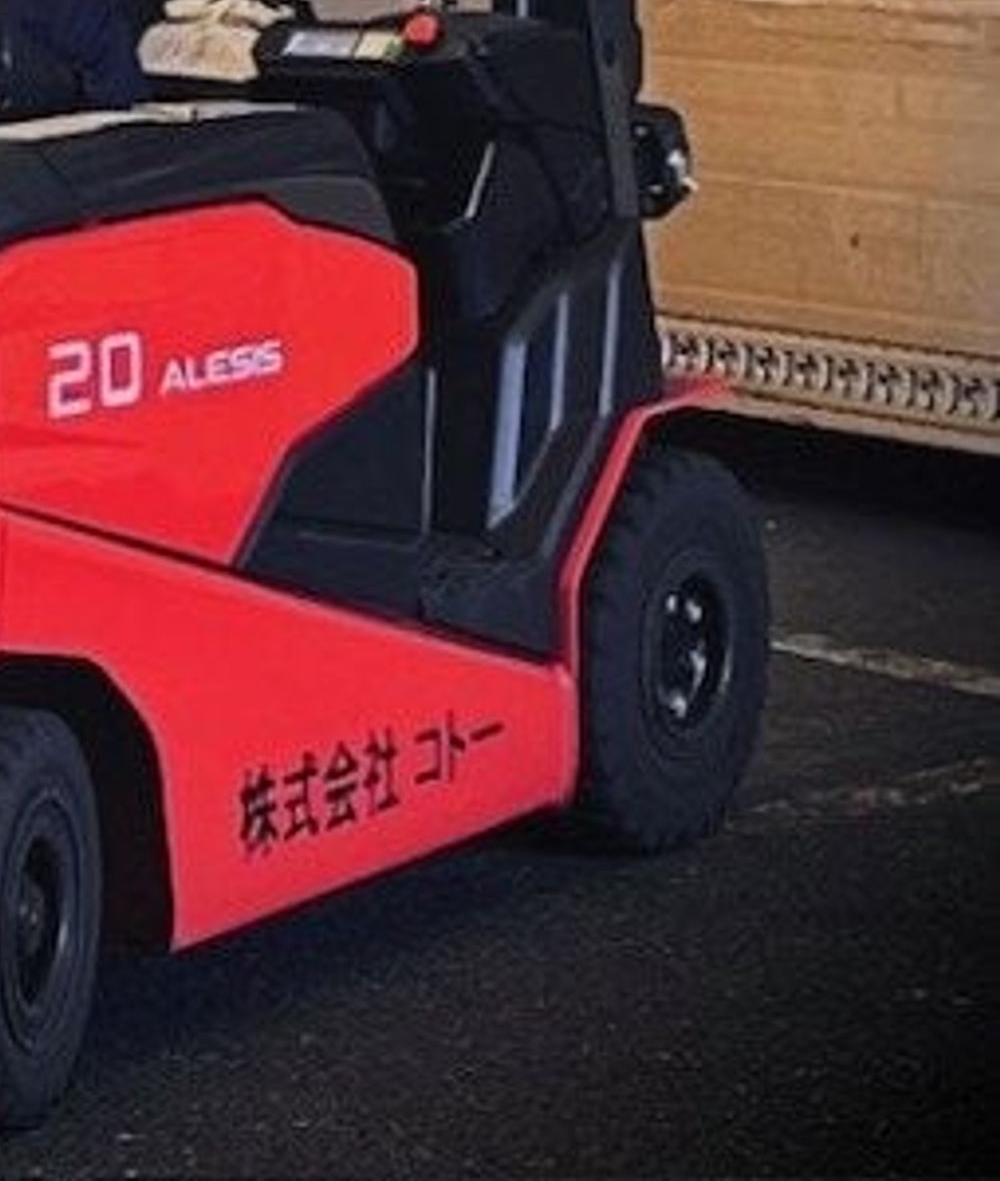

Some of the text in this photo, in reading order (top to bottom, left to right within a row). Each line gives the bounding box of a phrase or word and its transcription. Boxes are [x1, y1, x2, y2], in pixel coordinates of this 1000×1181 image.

[48, 330, 142, 419] 20
[240, 726, 399, 858] 株式会社
